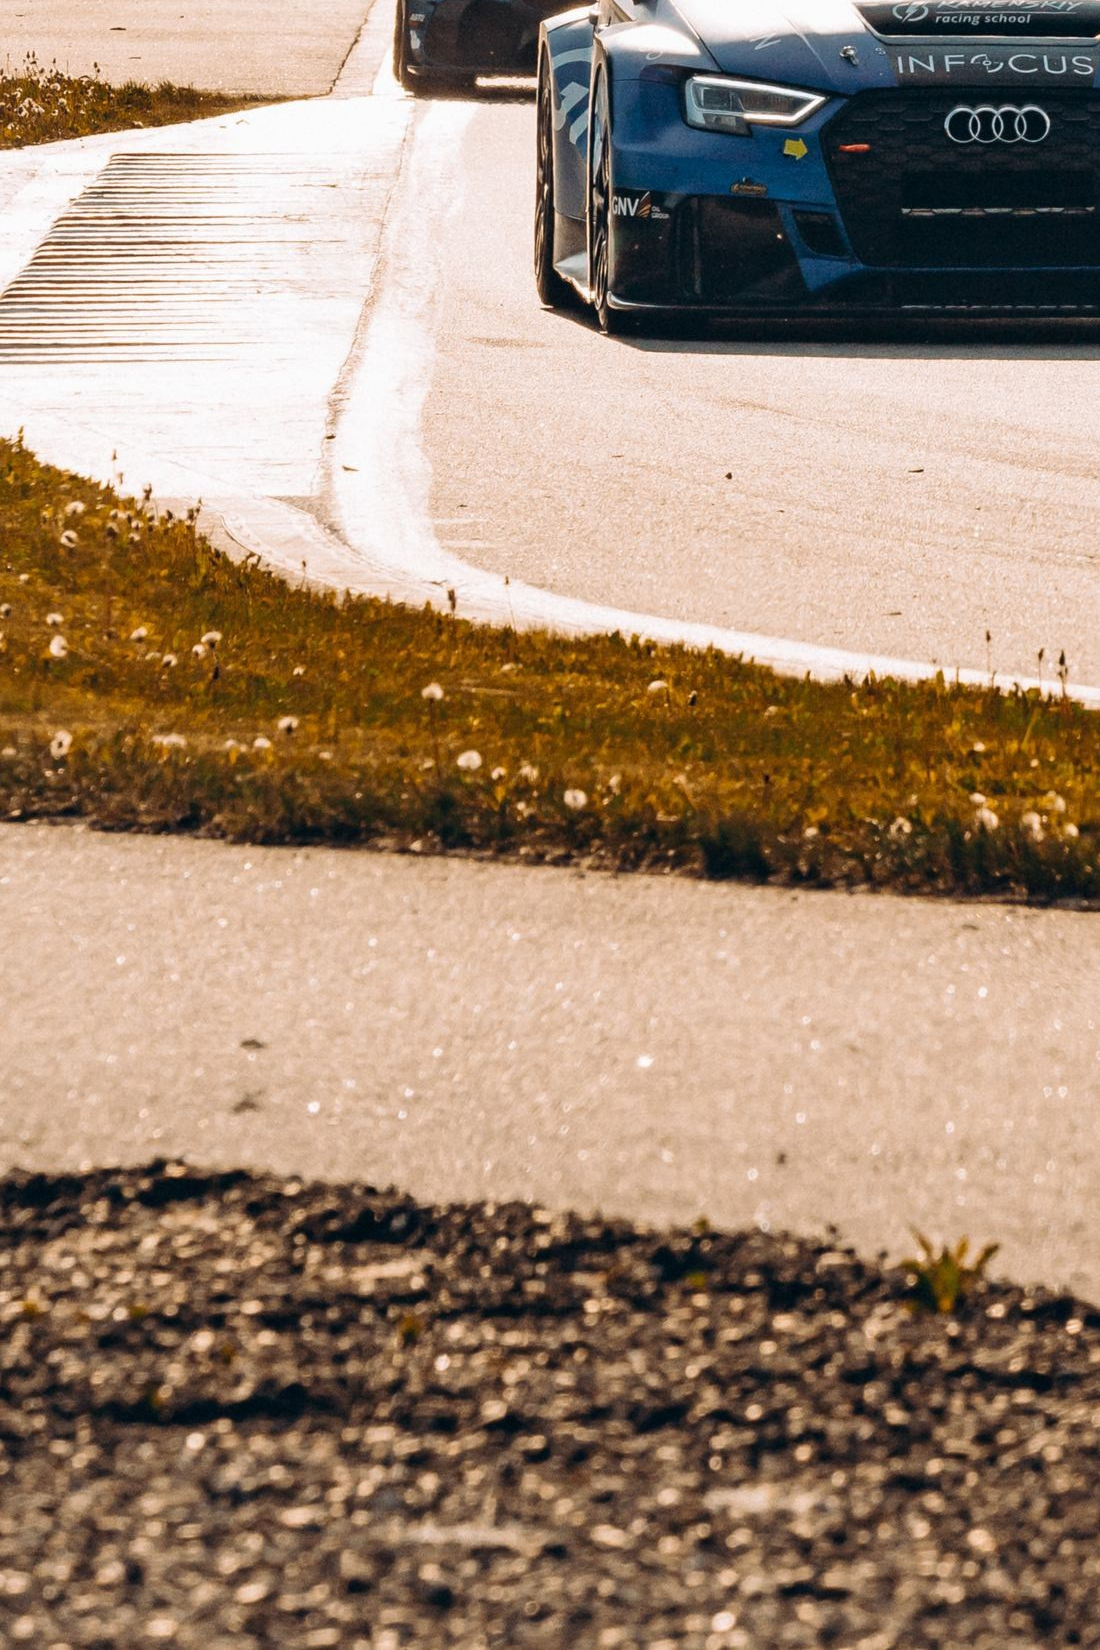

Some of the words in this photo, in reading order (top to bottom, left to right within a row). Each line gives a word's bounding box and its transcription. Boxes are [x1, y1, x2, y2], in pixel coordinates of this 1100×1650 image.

[936, 14, 979, 25] racing
[984, 13, 1031, 25] school
[611, 195, 640, 217] GNV
